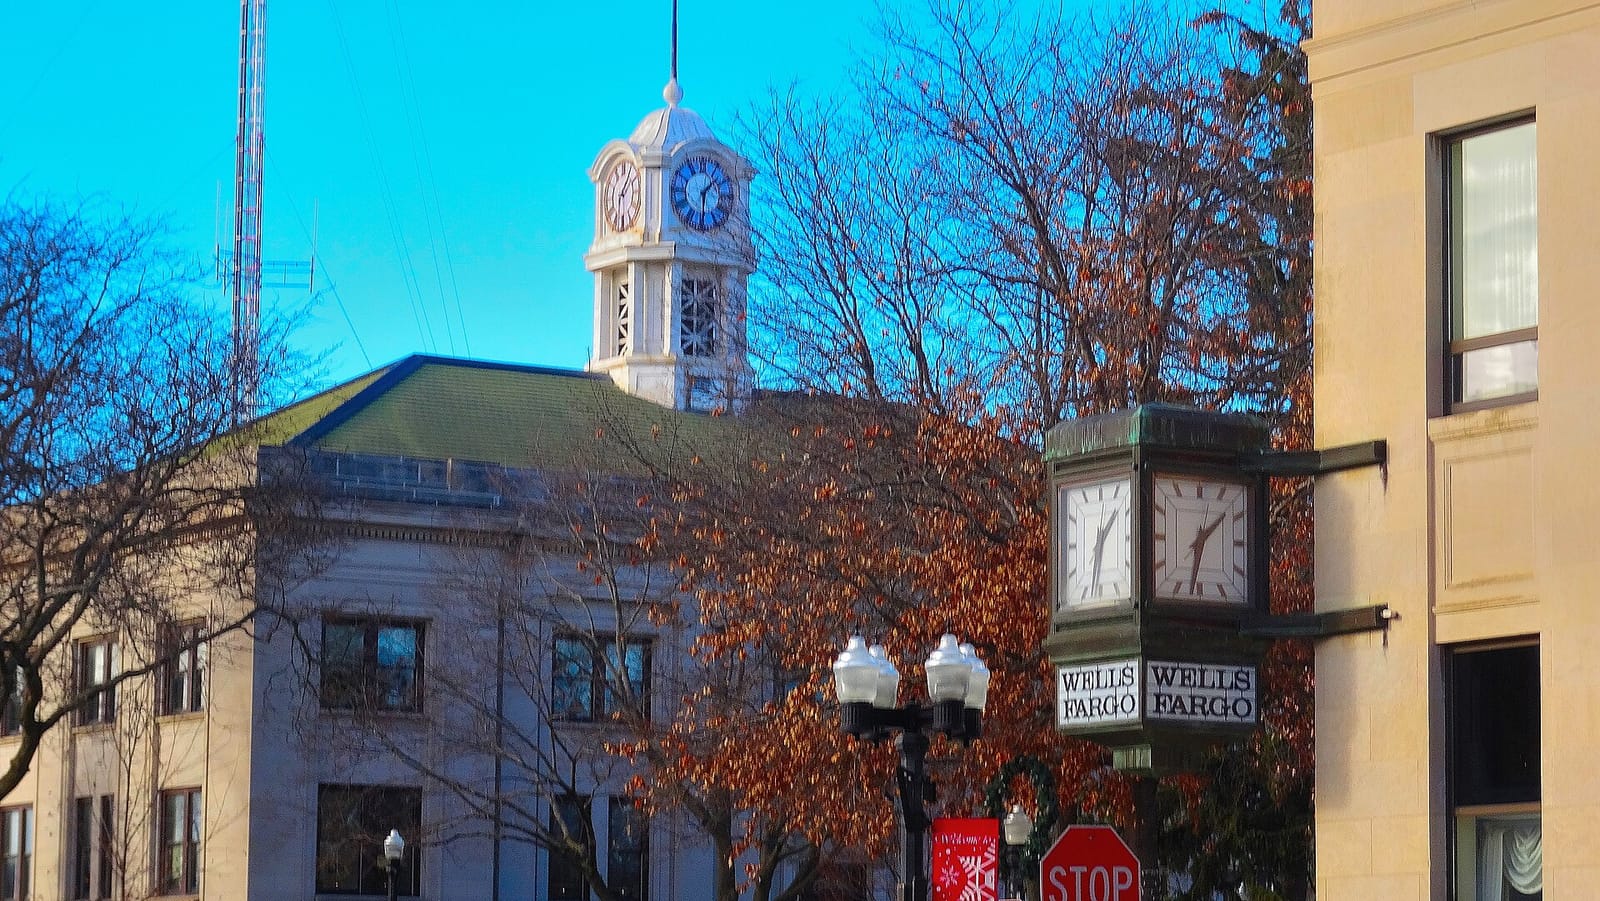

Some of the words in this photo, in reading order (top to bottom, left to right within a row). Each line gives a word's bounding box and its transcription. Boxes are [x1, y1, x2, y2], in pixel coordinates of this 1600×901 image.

[1062, 667, 1134, 691] WELLS
[1151, 666, 1250, 690] WELLS
[1064, 694, 1135, 719] FARGO
[1153, 693, 1252, 720] FARGO
[1049, 865, 1133, 901] STOP
